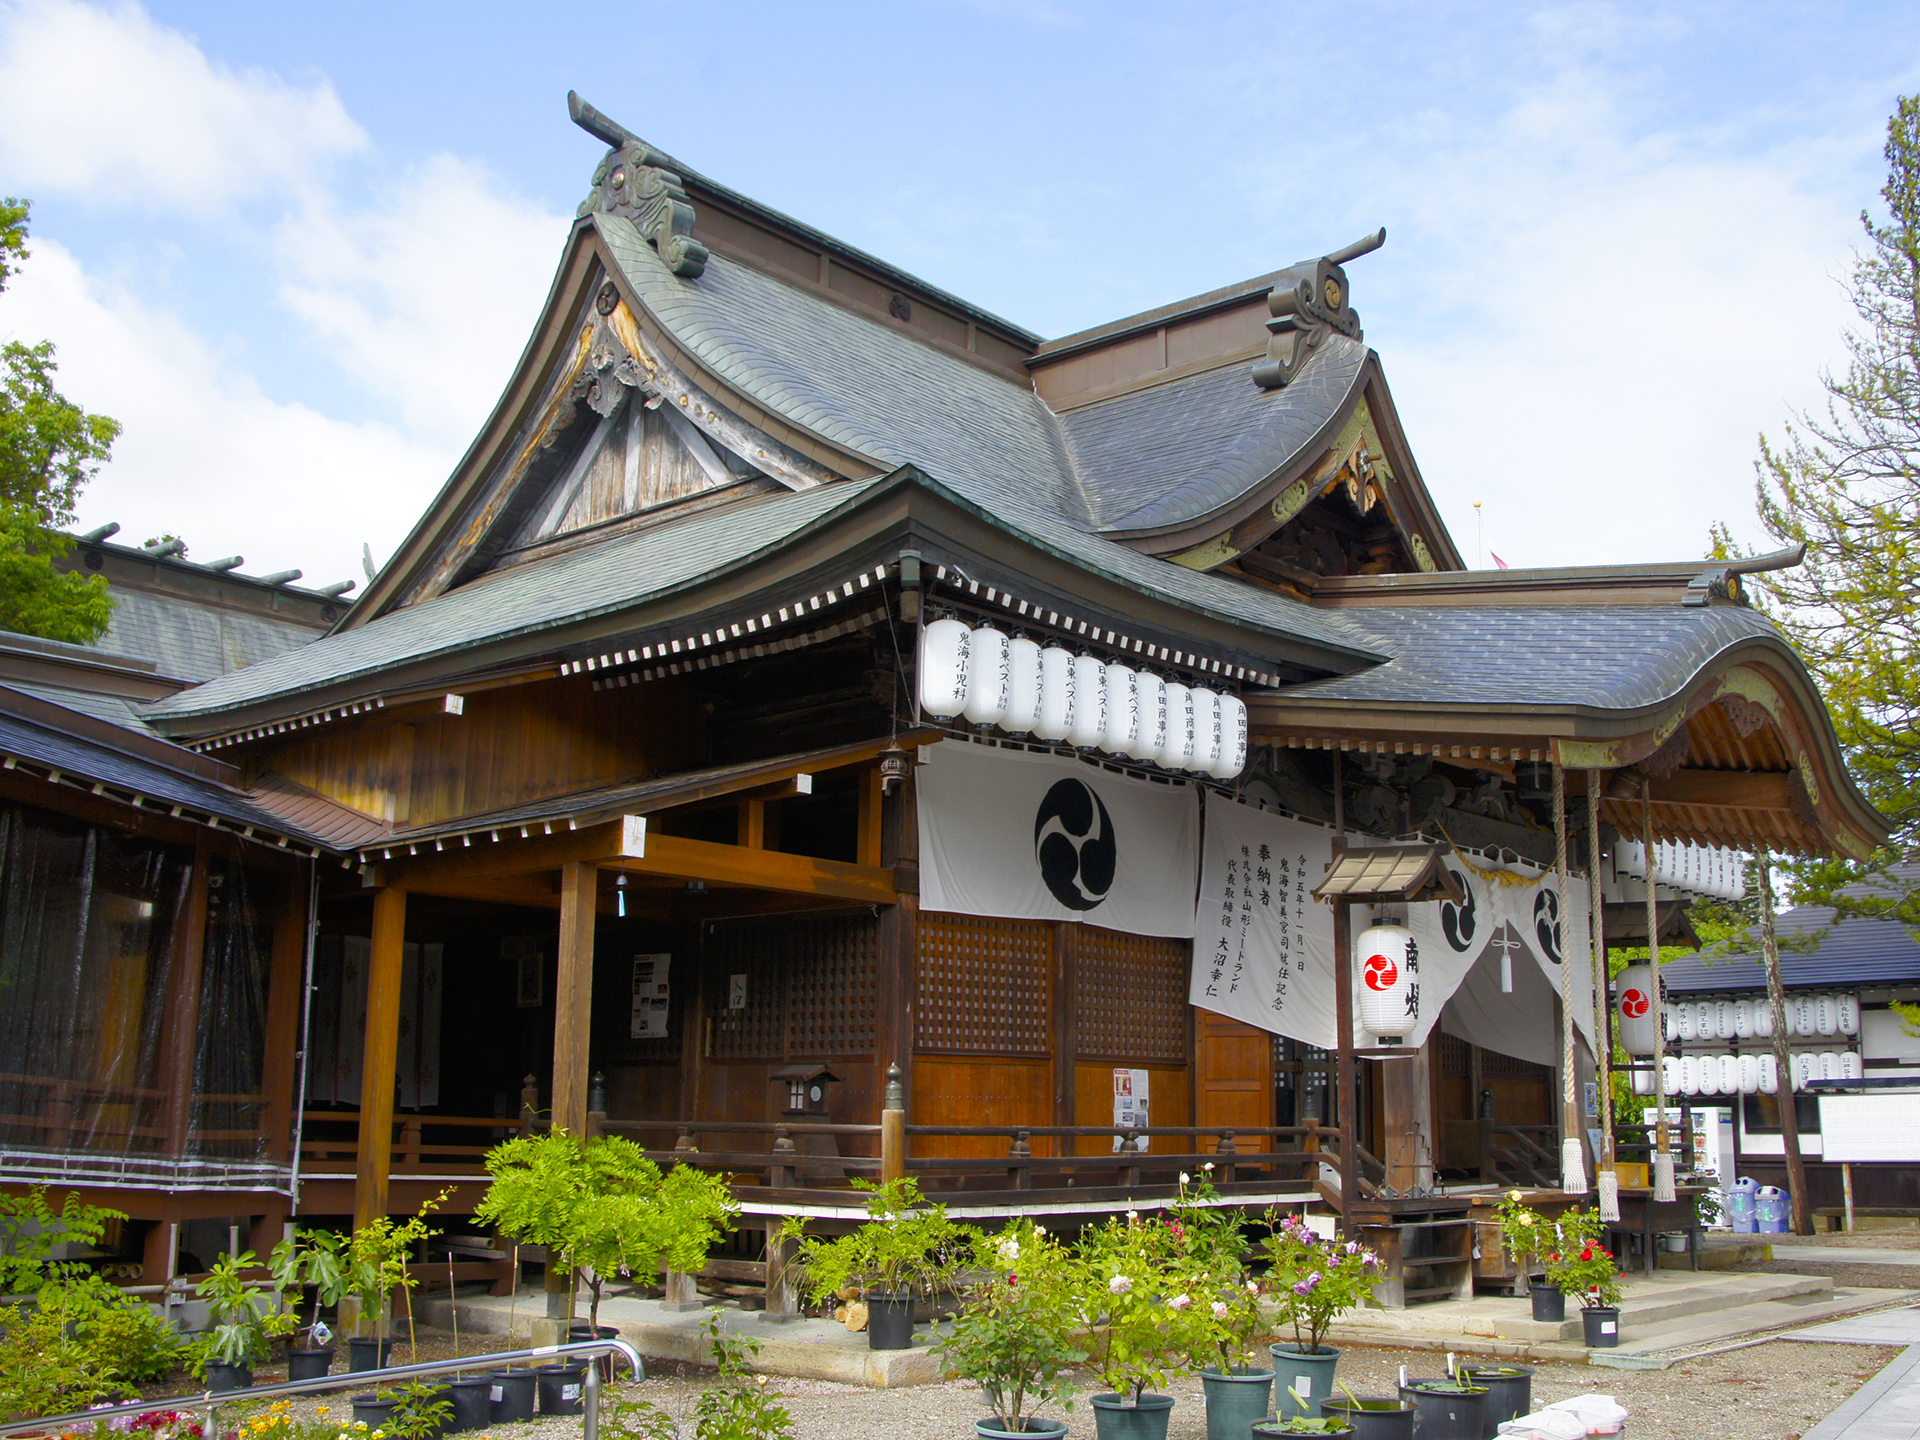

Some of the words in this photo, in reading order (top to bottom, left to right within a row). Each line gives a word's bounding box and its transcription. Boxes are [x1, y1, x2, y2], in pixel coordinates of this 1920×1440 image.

[952, 631, 971, 702] 鬼海小児科
[999, 638, 1010, 694] 日東ベスト
[1036, 649, 1044, 704] 日東ベスト
[1066, 657, 1076, 711] 日東ベスト
[1097, 665, 1108, 718] 日東ベスト
[1128, 673, 1139, 726] 日東ベスト
[1157, 682, 1166, 732] 角田商事
[1185, 692, 1194, 741] 角田商事
[1212, 697, 1221, 745] 角田商事
[1237, 704, 1246, 753] 角田商事
[1221, 859, 1237, 928] 代表取締役
[1257, 843, 1272, 907] 奉納者
[1271, 858, 1290, 1011] 鬼海智美宮司就任記念
[1296, 854, 1307, 972] 令和五年十一月一日
[1205, 936, 1229, 998] 大沼幸仁
